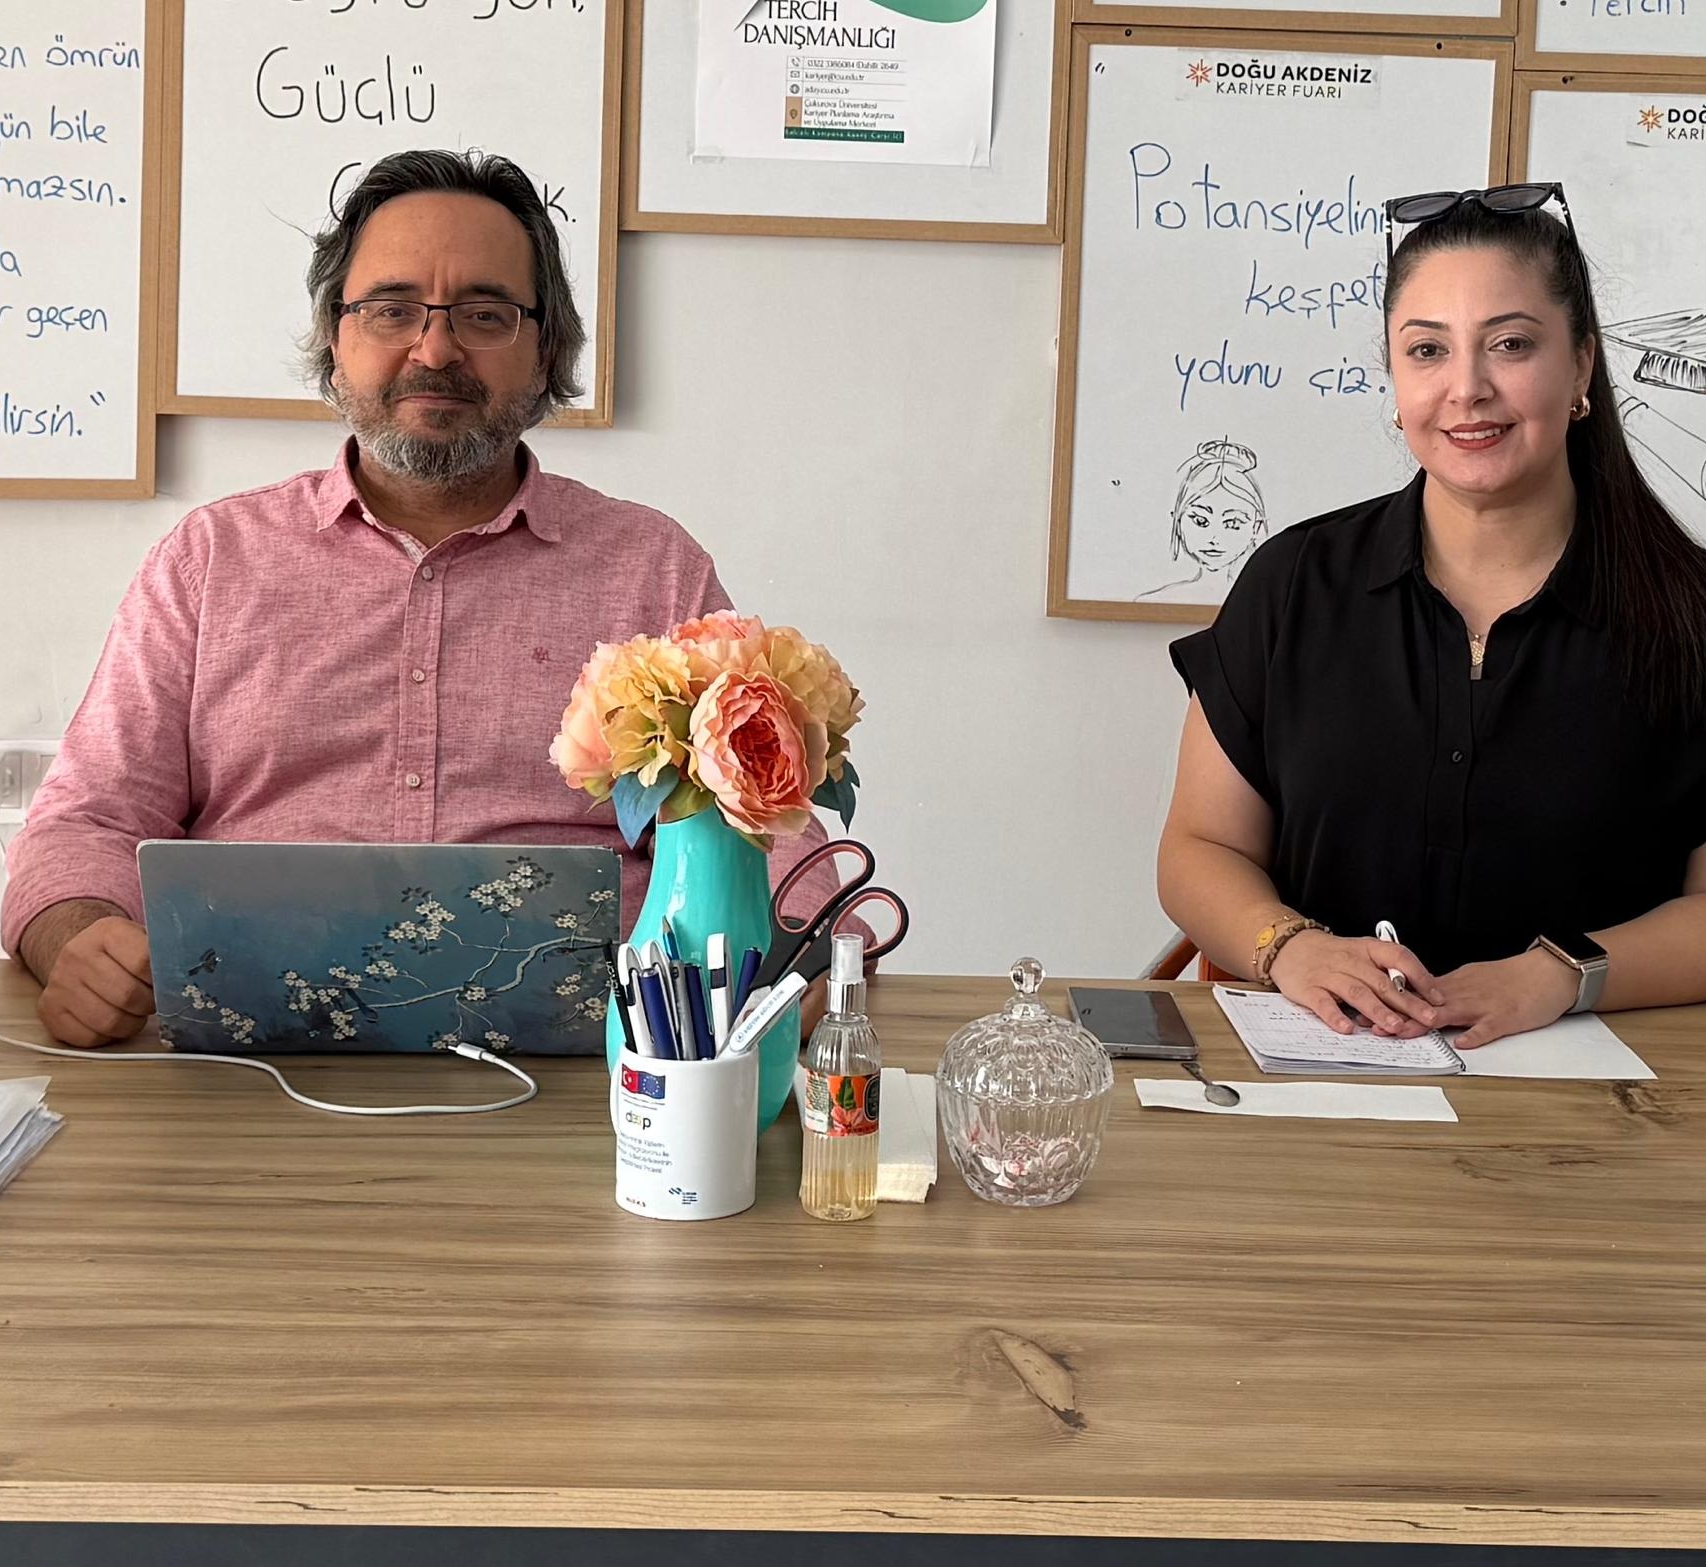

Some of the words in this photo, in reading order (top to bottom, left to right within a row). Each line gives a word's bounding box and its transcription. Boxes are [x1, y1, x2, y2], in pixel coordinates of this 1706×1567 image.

[45, 33, 141, 69] ömrün
[744, 23, 895, 50] DANIŞMANLIĞI
[256, 45, 435, 127] Güçlü
[1216, 58, 1277, 80] DOĞU
[1280, 62, 1373, 84] AKDENİZ
[1215, 79, 1287, 97] KARİYER
[1292, 84, 1342, 100] FUARI
[49, 104, 109, 144] bile
[25, 305, 108, 339] geçen
